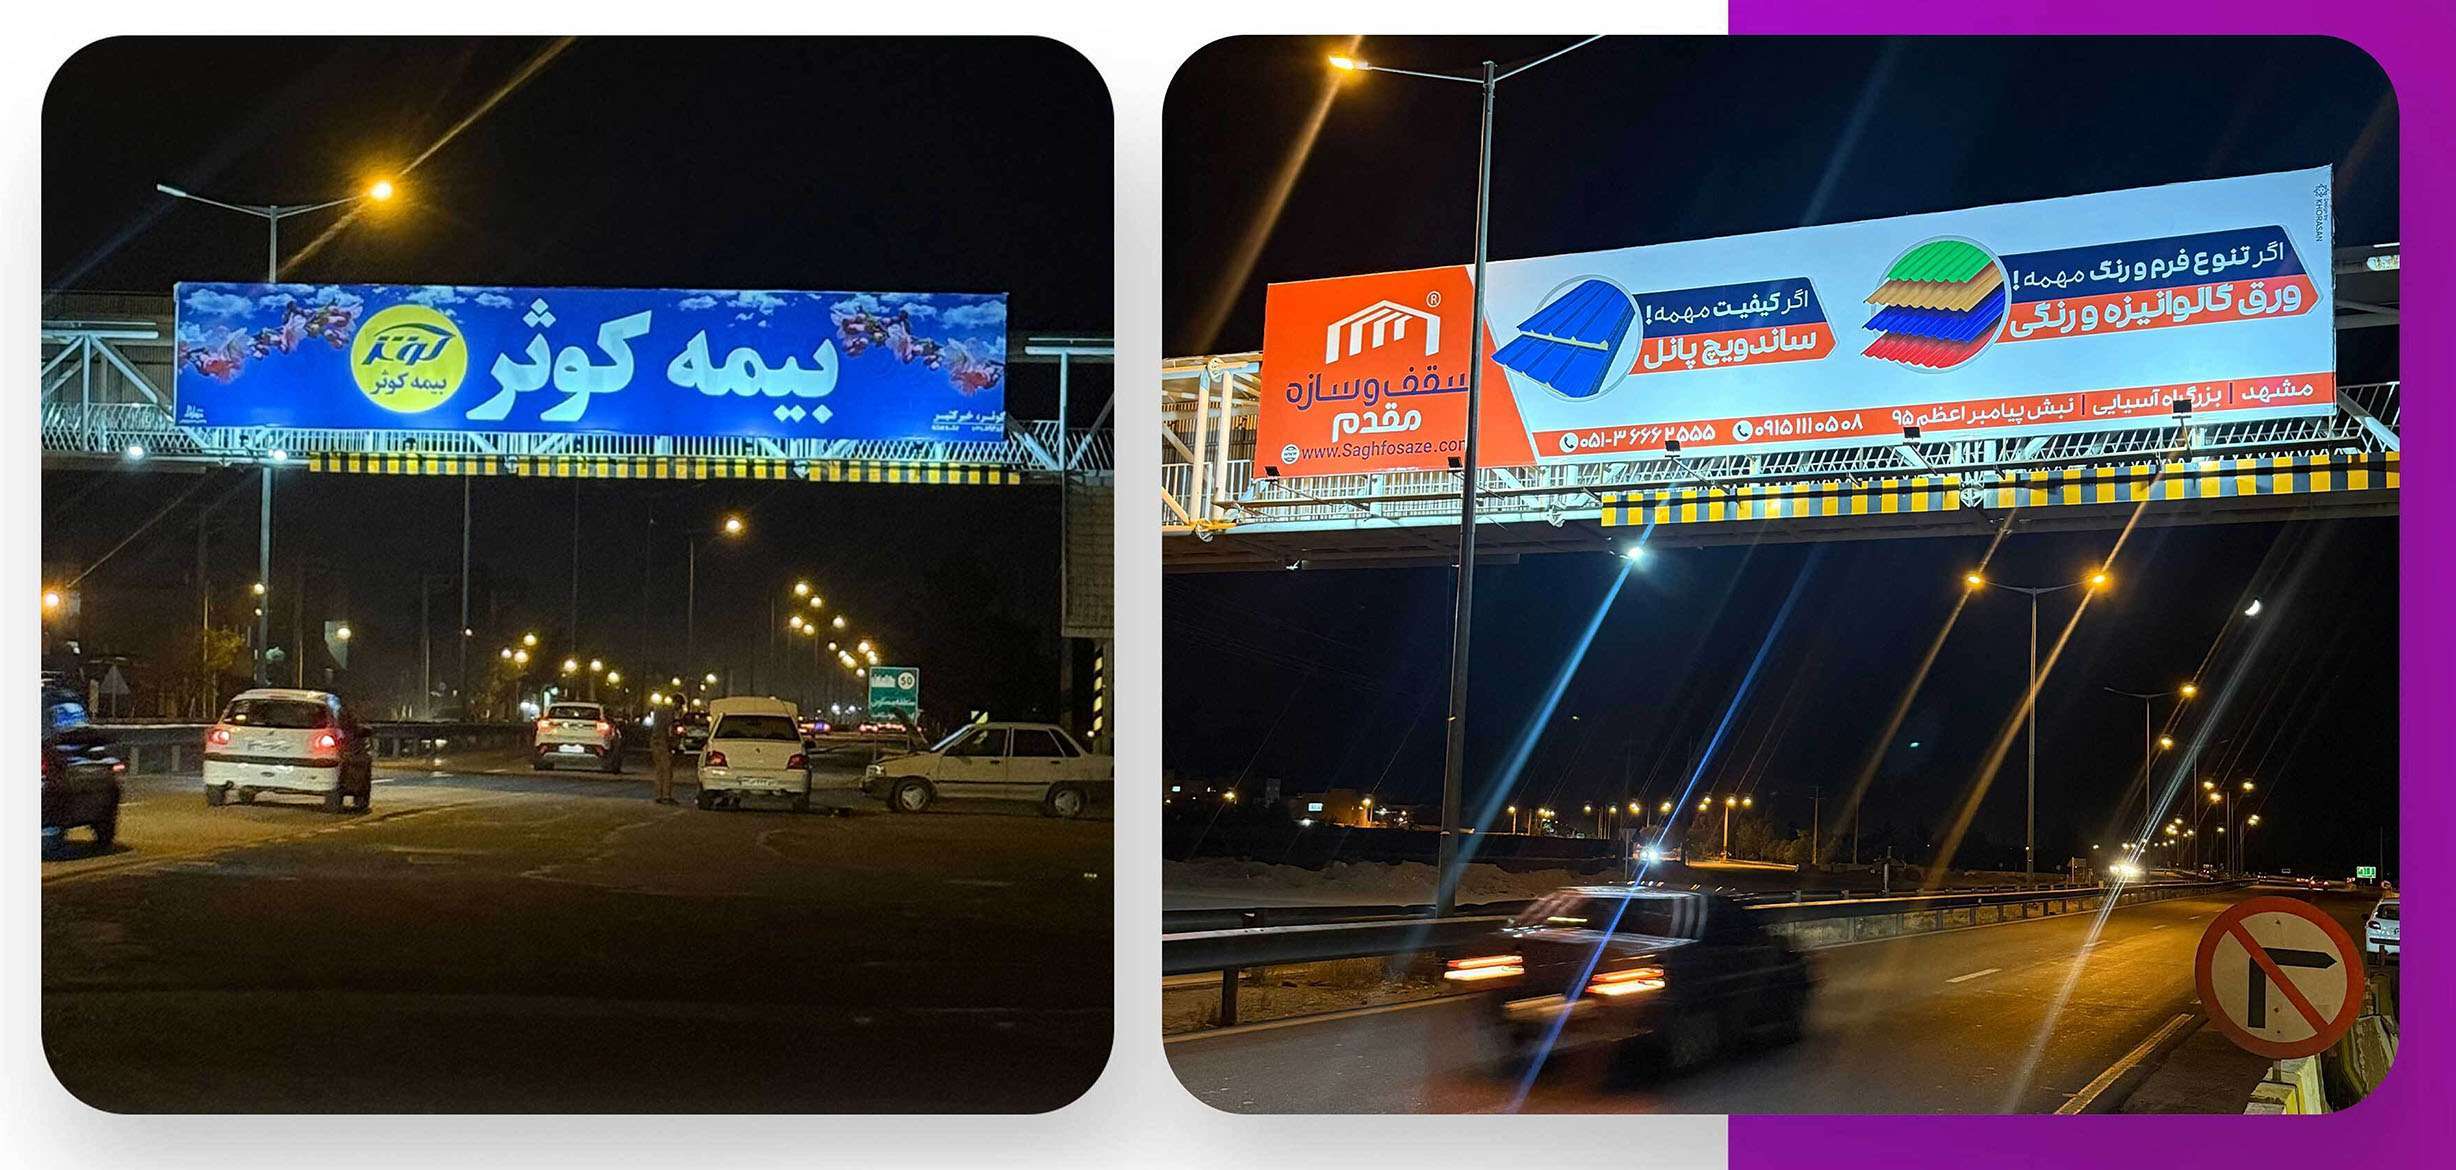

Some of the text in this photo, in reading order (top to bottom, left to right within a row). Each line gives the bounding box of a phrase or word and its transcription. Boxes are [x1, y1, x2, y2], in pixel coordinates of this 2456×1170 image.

[2315, 198, 2324, 241] KHORASAN
[2089, 258, 2131, 283] رنگ
[2133, 260, 2147, 281] و
[2150, 247, 2190, 279] فرم
[2193, 244, 2251, 276] تنوع
[2252, 240, 2284, 269] اگر
[1713, 291, 1780, 319] کیفیت
[1781, 288, 1809, 315] اگر
[2009, 281, 2302, 338] ورق گالوانیزه و رنگی
[466, 297, 839, 424] بیمه کوثر
[1643, 327, 1817, 370] ساندویچ پانل
[369, 369, 448, 395] بیمه کوثر
[1891, 378, 2315, 427] مشهد بزرگاه آسیایی نبش پیامبر اعظم ۹۵
[1331, 402, 1422, 443] مقدم
